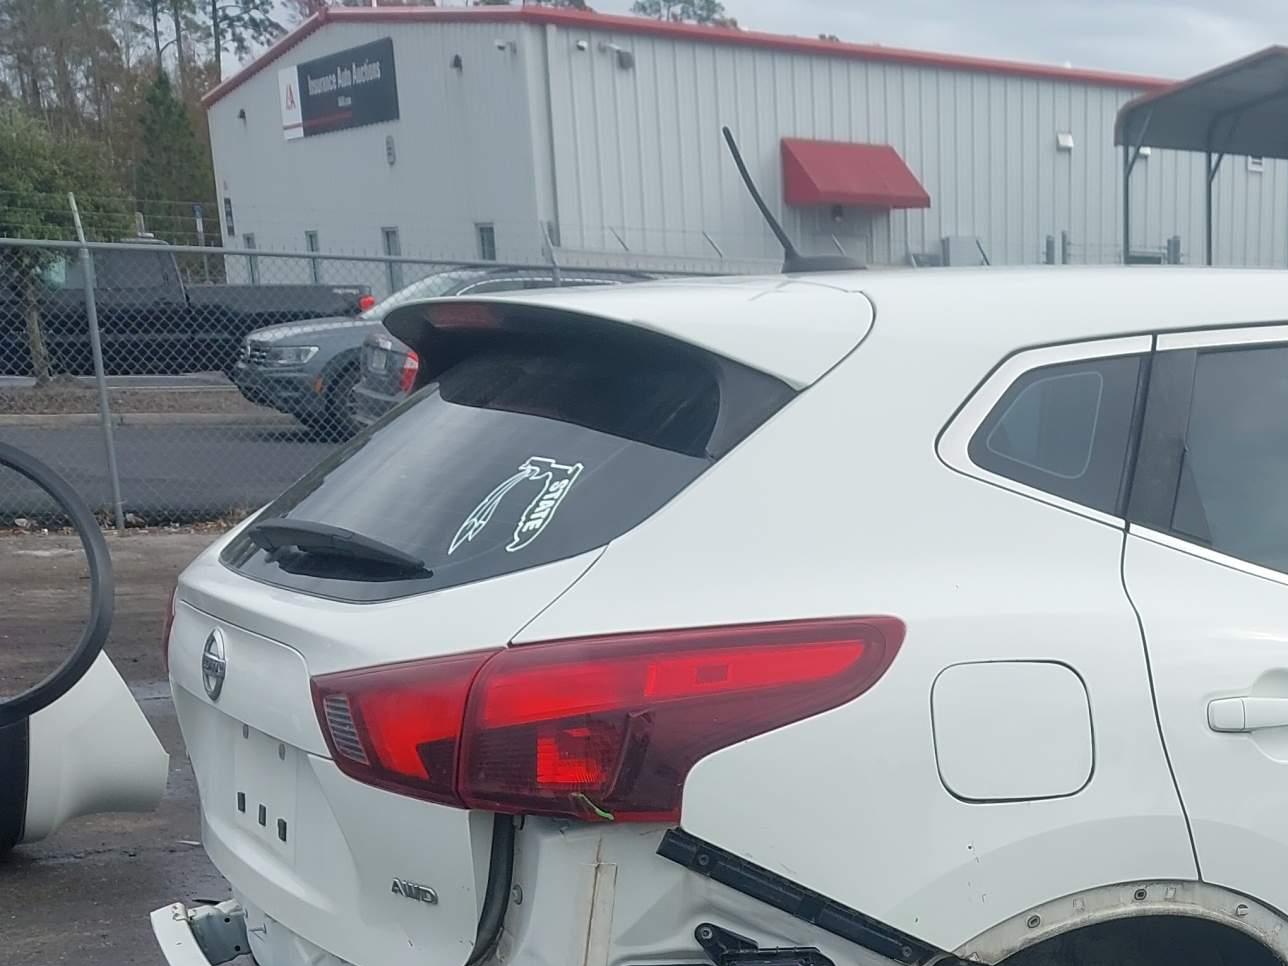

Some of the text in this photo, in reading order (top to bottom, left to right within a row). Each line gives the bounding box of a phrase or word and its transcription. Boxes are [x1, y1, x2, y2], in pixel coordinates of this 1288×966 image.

[337, 65, 352, 88] Auto
[352, 58, 381, 85] Auctions
[521, 478, 570, 533] STATE
[391, 877, 439, 905] AWD
